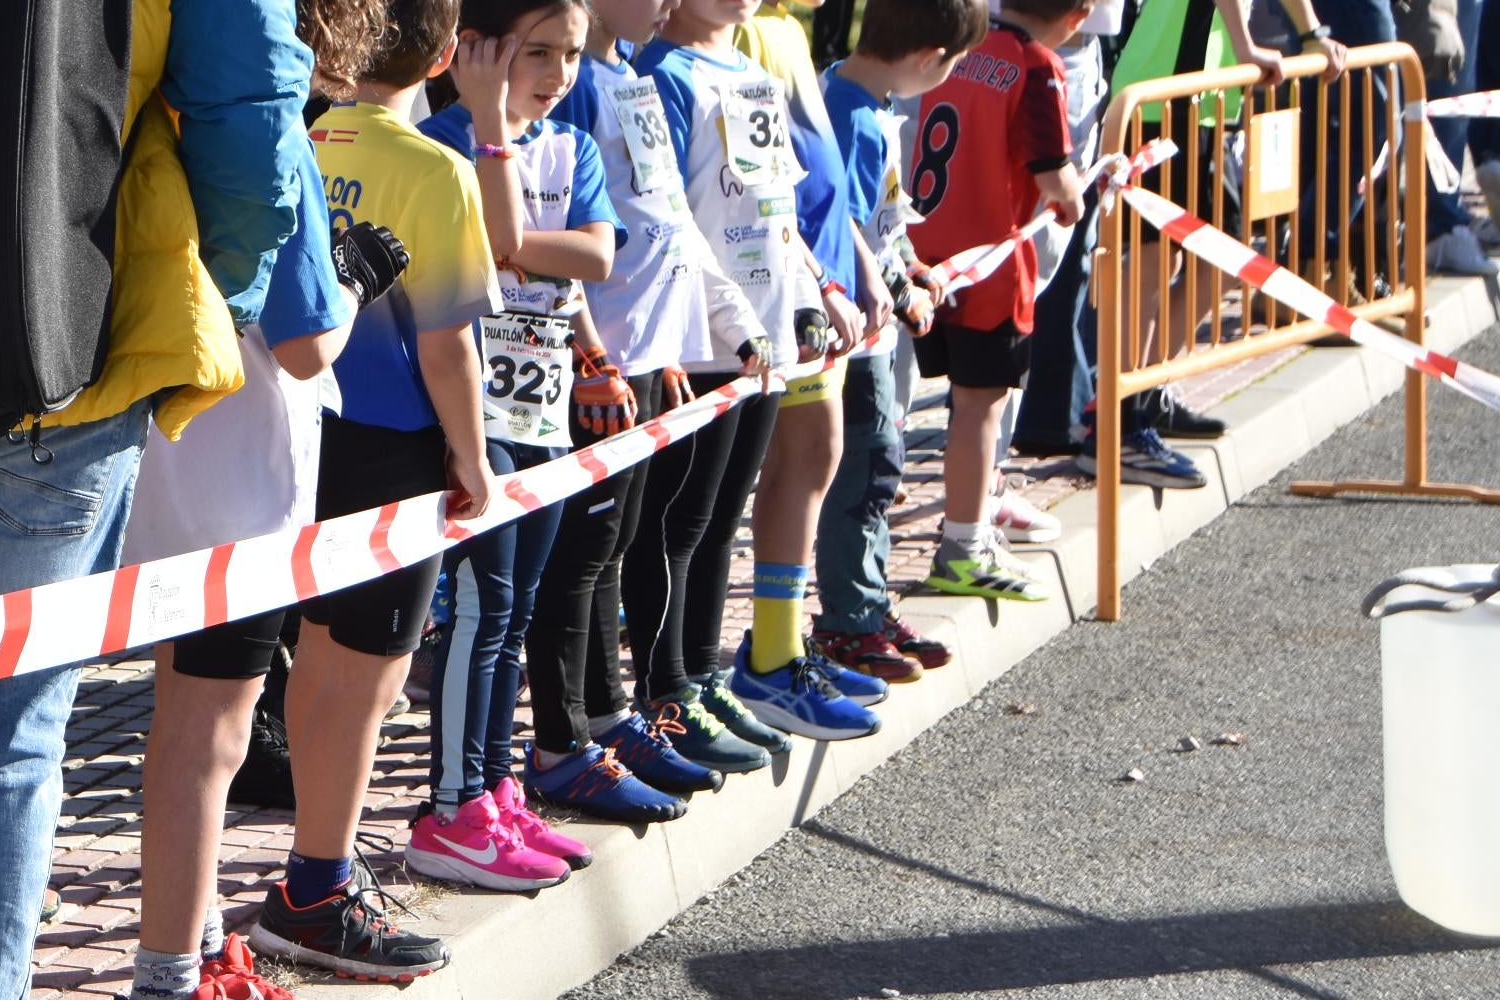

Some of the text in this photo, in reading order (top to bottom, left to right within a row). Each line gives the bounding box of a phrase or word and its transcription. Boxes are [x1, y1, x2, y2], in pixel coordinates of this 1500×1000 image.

[633, 109, 668, 151] 33
[911, 101, 961, 216] 8
[485, 327, 524, 343] DUATLÓN
[487, 354, 563, 406] 323
